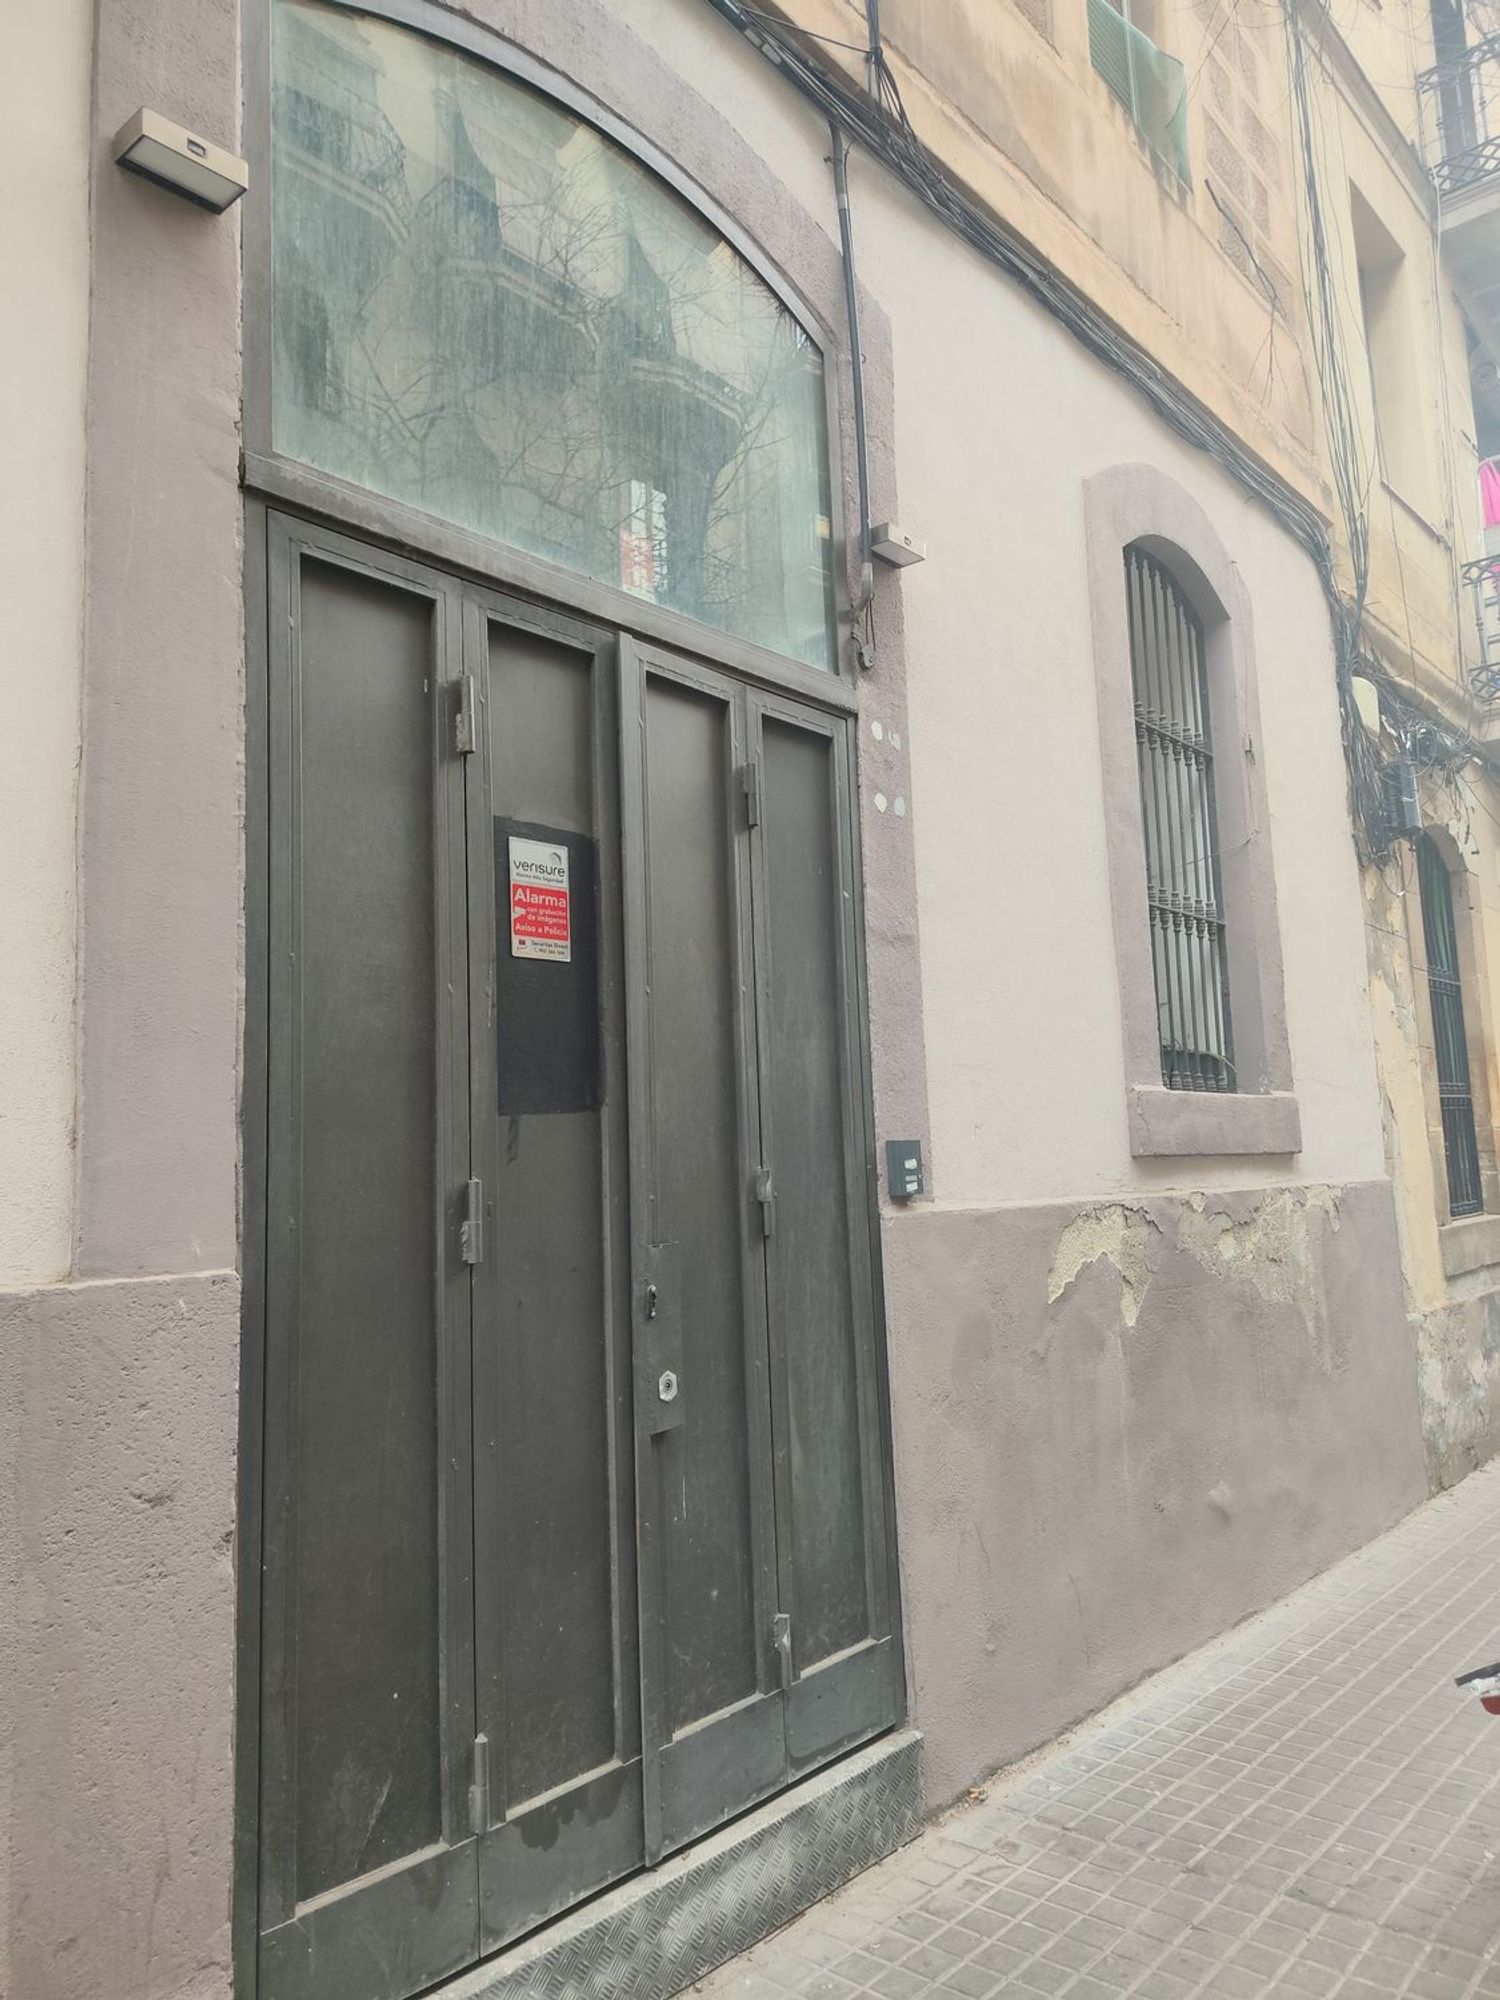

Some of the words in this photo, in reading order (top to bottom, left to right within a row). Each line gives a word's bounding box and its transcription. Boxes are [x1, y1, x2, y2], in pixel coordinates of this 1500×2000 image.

[513, 859, 565, 877] verisure
[514, 887, 567, 908] Alarma
[514, 921, 536, 932] Aviso
